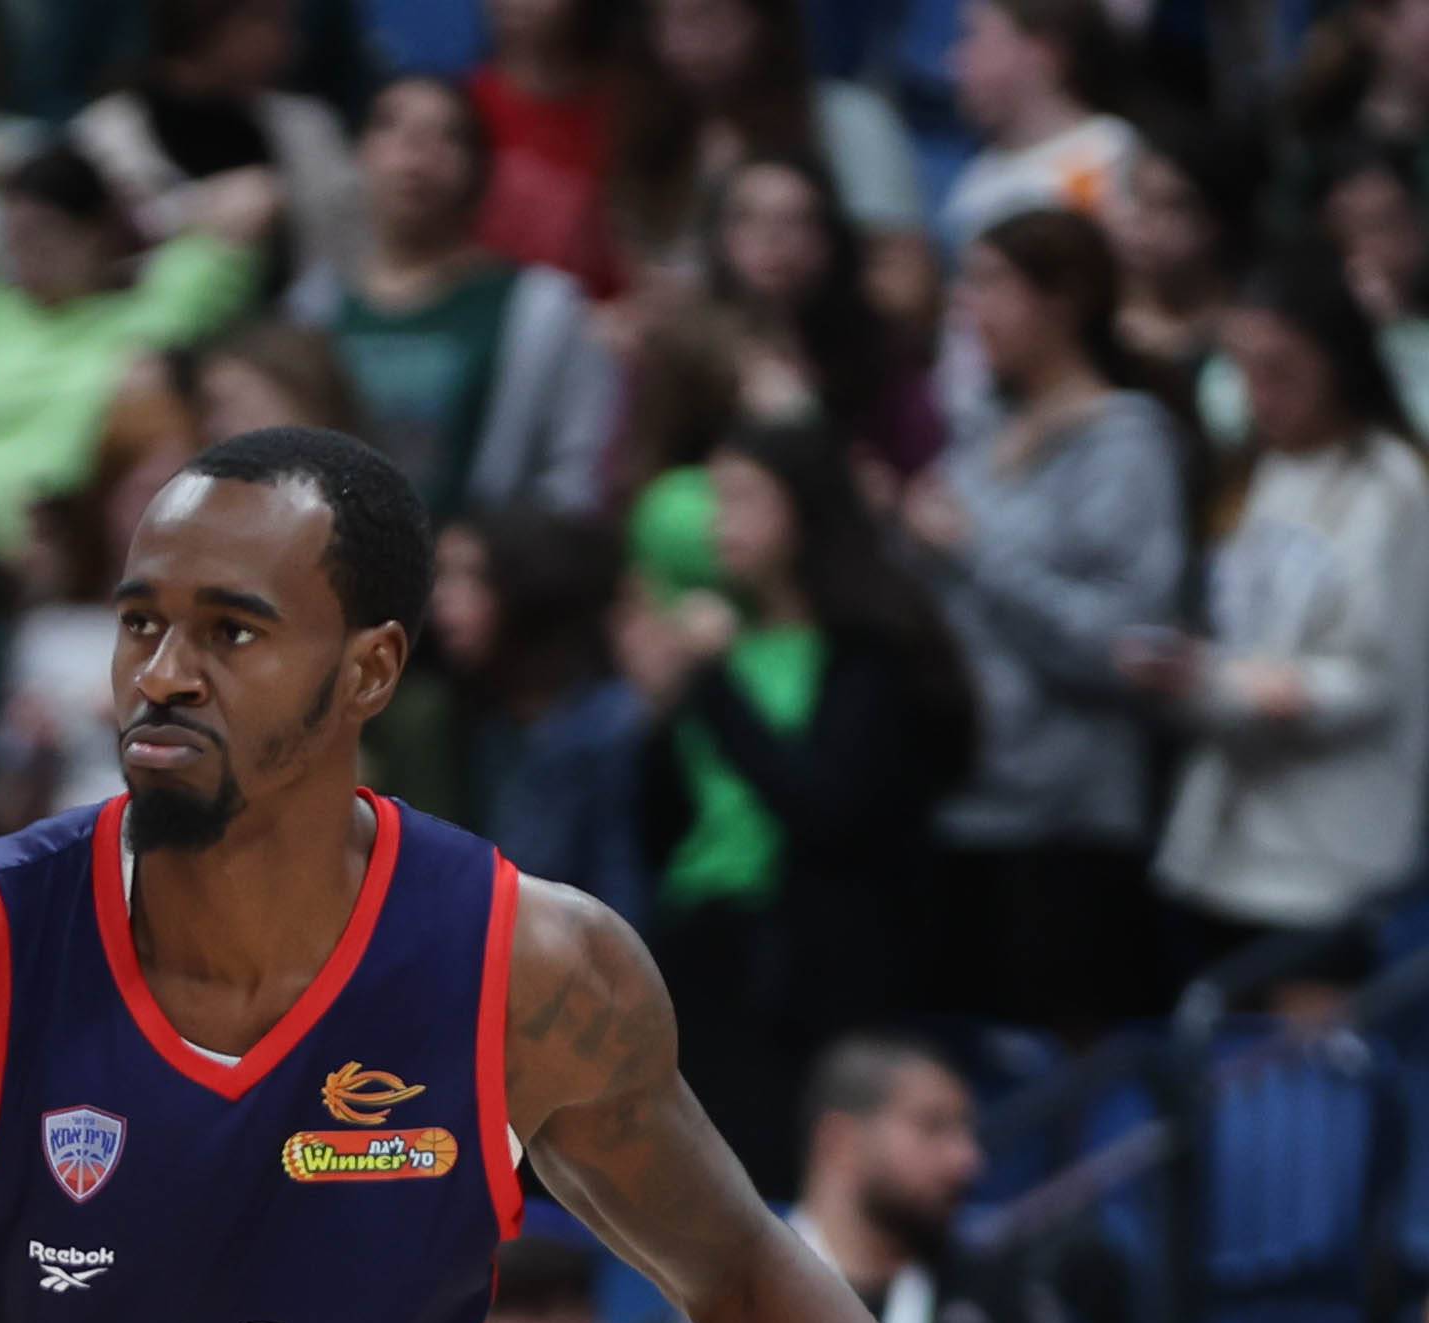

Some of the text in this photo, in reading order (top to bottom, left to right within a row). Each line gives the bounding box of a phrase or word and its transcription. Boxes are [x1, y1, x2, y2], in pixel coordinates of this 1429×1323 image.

[369, 1136, 405, 1154] ליגת
[303, 1143, 407, 1172] Winner
[409, 1149, 434, 1168] סל
[29, 1240, 114, 1265] Reebok
